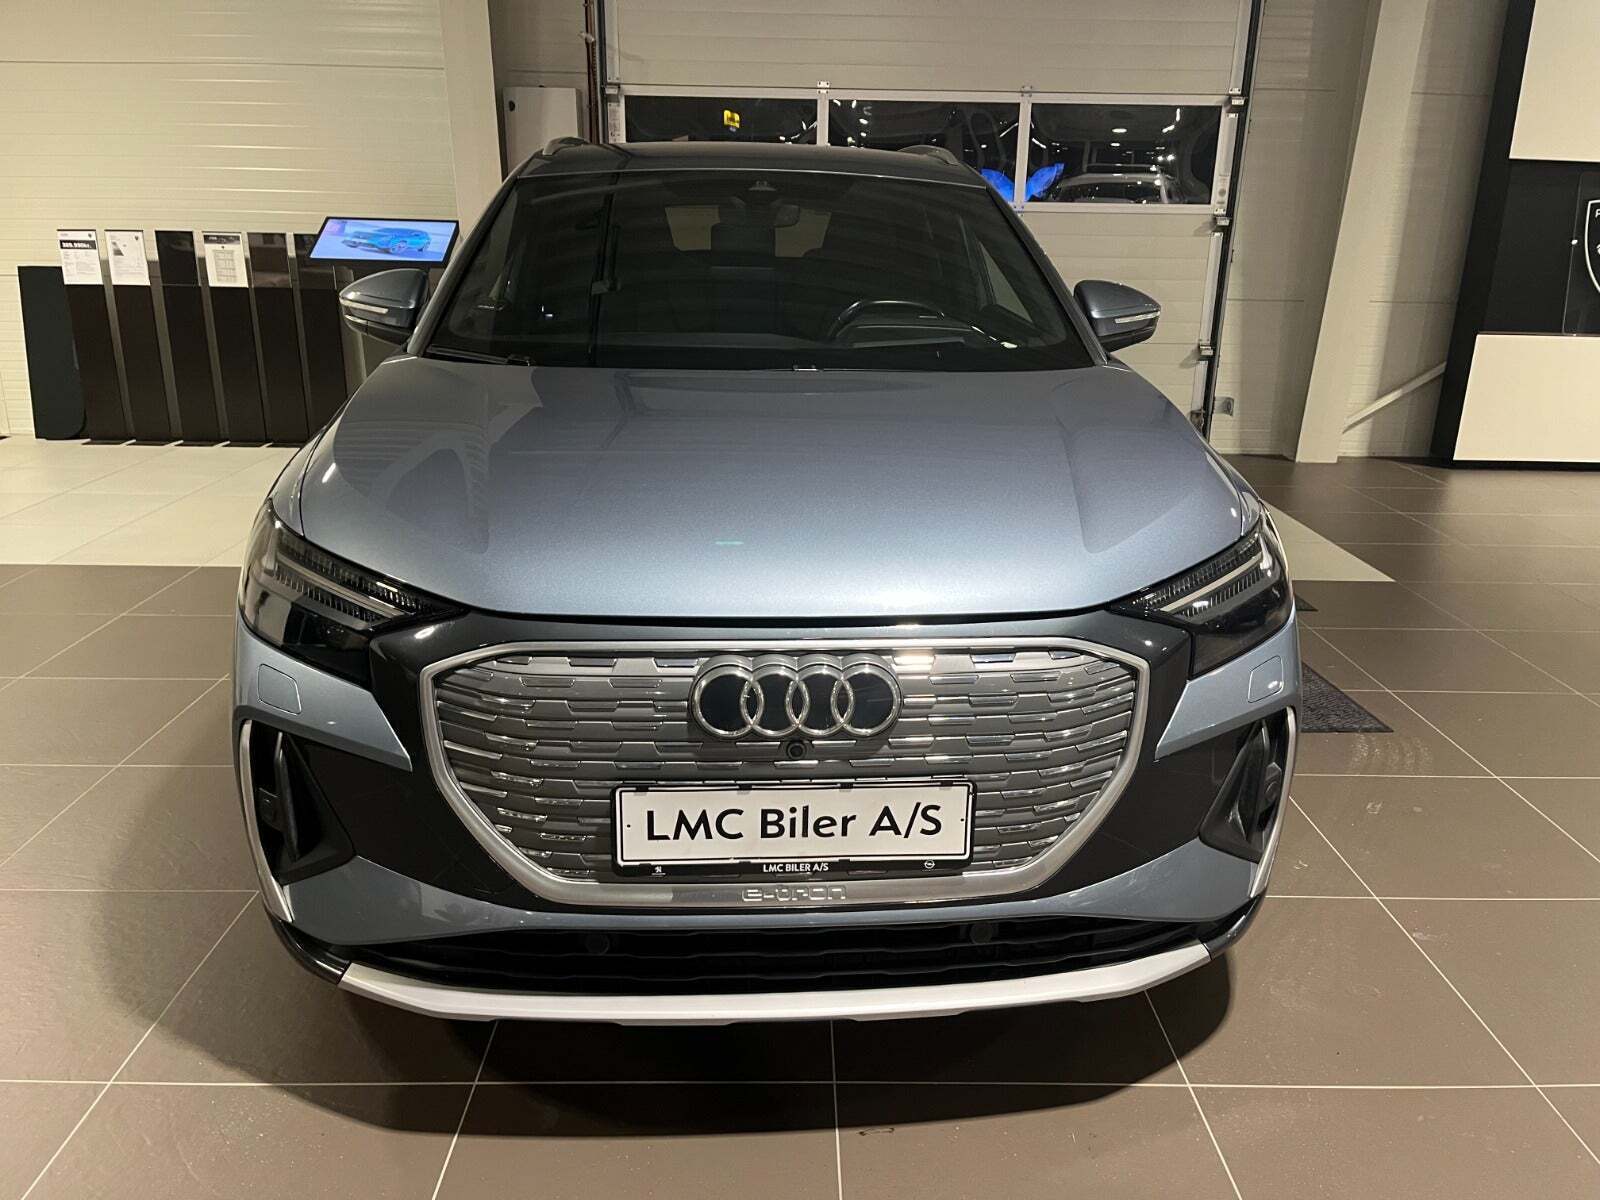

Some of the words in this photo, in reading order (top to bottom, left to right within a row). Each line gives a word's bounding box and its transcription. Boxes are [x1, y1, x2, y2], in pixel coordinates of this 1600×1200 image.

[647, 808, 744, 841] LMC
[760, 805, 856, 839] Biler
[869, 802, 942, 838] A/S
[763, 863, 784, 873] LMC
[785, 863, 811, 872] BILER
[812, 862, 829, 872] A/S
[742, 885, 846, 902] e-tron
